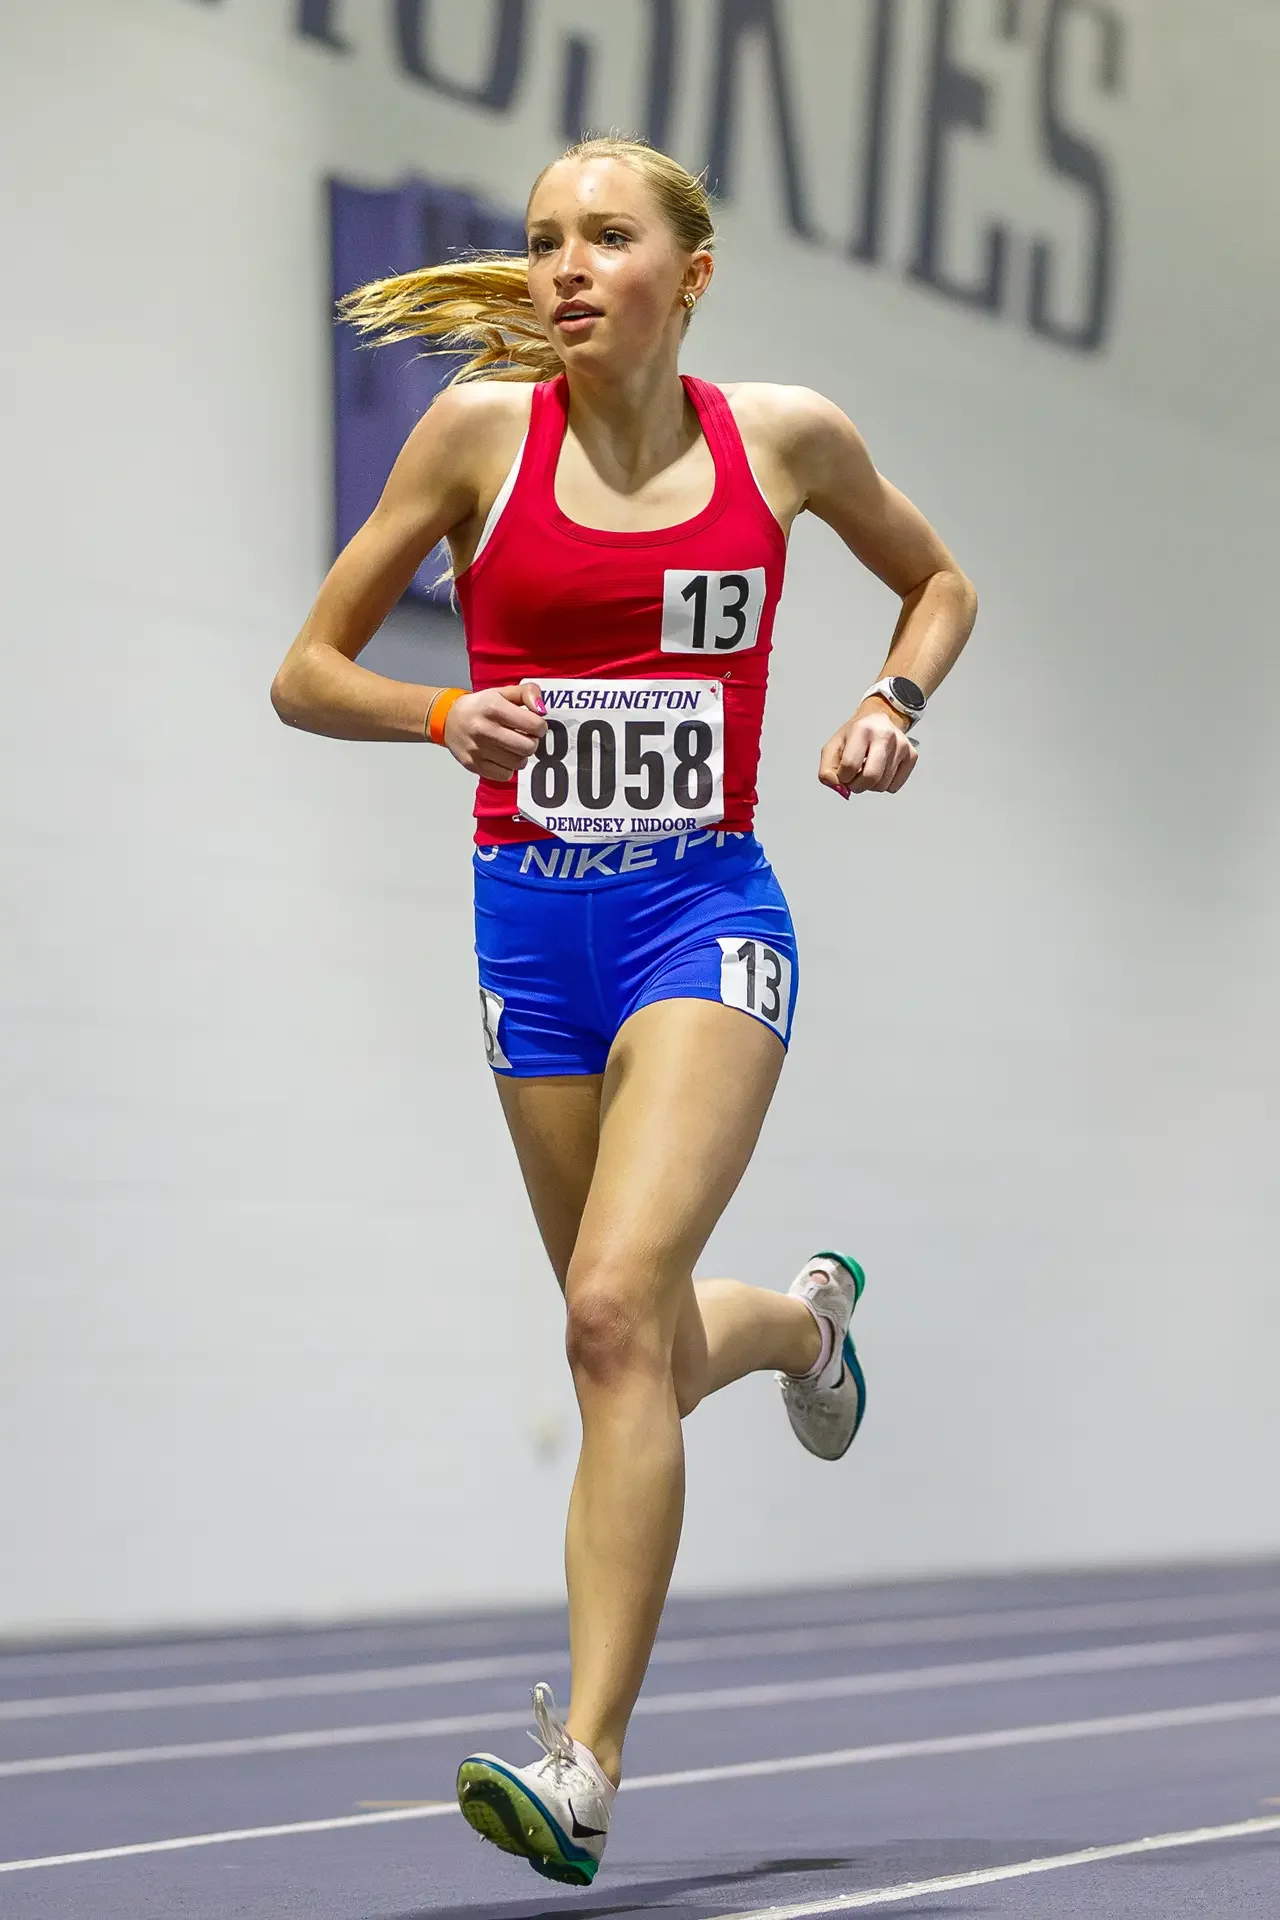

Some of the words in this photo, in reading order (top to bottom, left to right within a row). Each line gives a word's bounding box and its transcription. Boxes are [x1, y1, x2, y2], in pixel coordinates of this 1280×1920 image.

[681, 574, 749, 650] 13
[541, 690, 702, 710] WASHINGTON
[531, 719, 713, 810] 8058
[546, 816, 625, 832] DEMPSEY
[631, 817, 697, 832] INDOOR
[519, 840, 658, 879] NIKE
[737, 940, 782, 1022] 13
